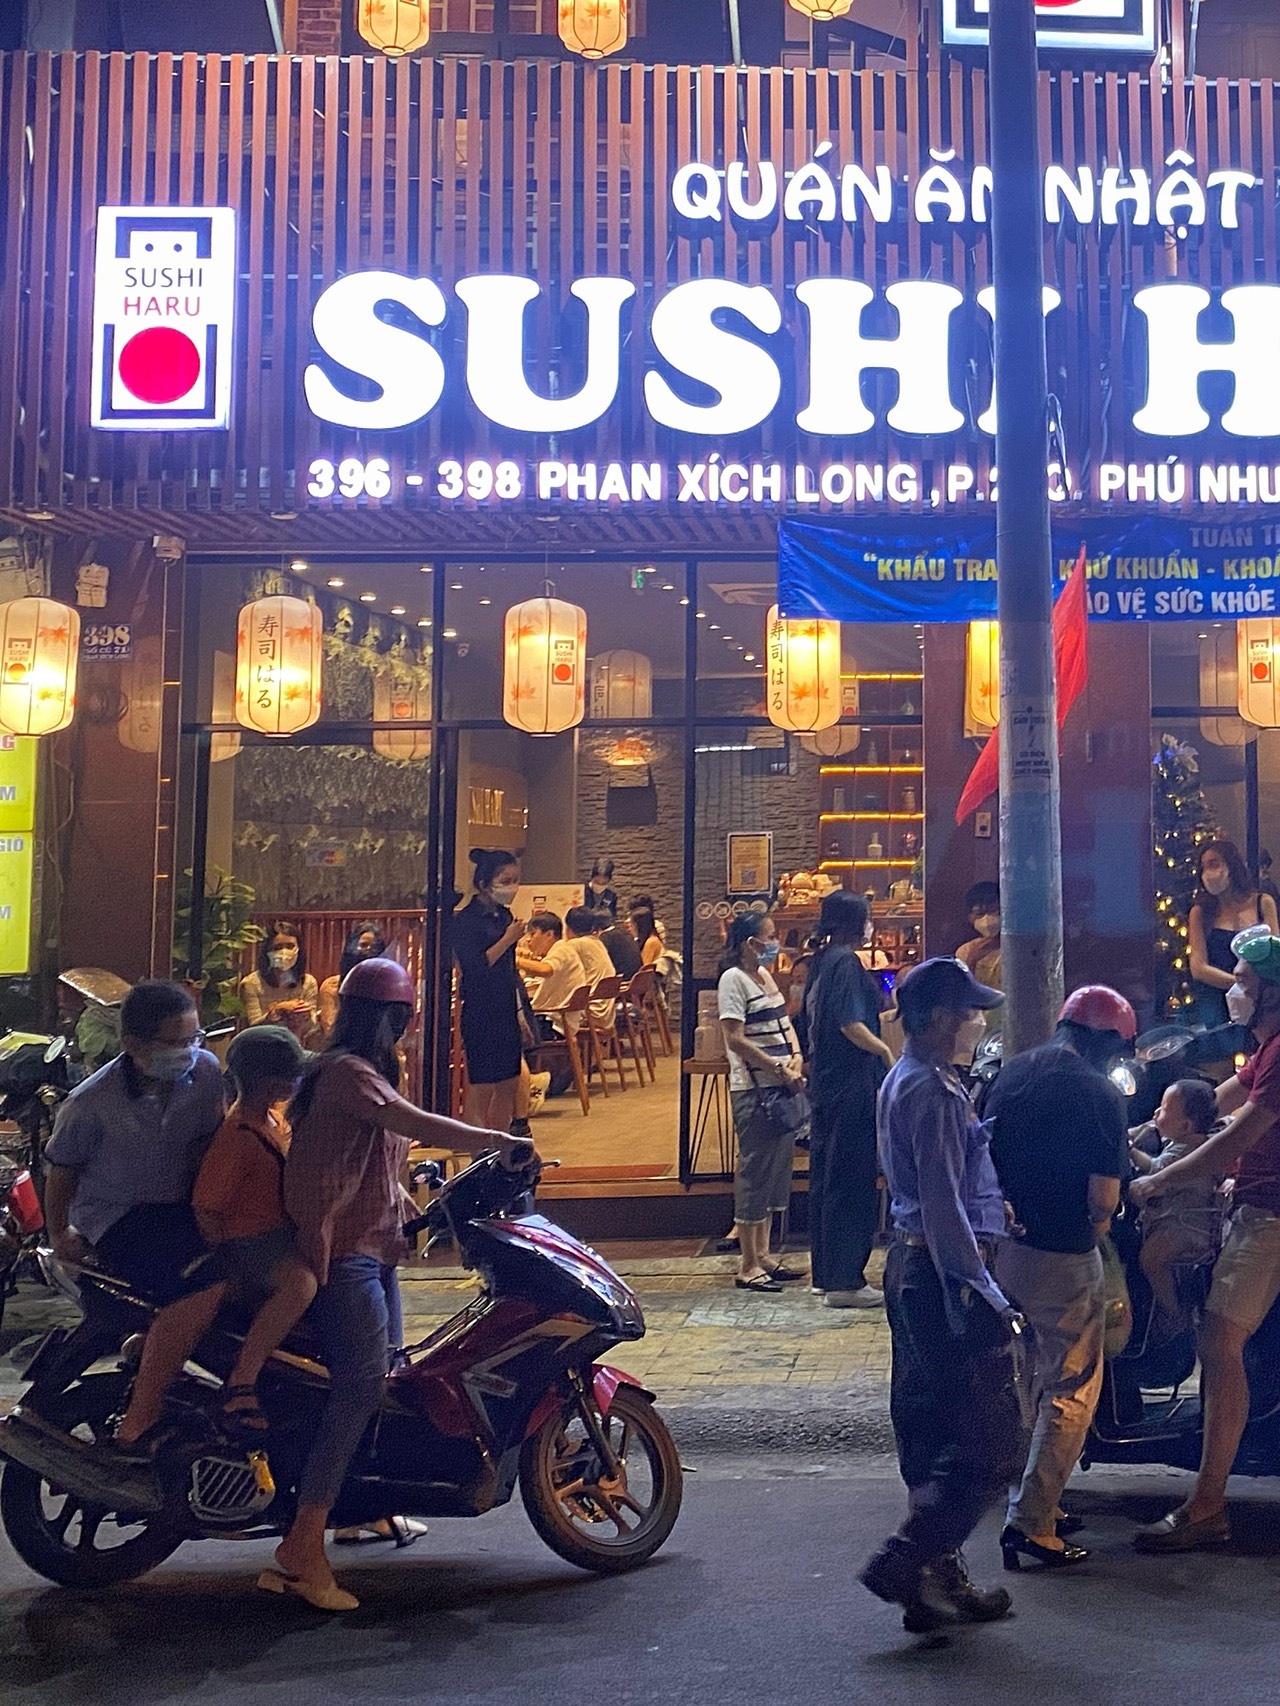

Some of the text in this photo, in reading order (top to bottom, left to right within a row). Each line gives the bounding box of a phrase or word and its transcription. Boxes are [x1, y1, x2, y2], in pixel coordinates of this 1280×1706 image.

[672, 140, 892, 223] QUÁN
[1044, 148, 1255, 240] NHẬT
[124, 267, 203, 288] SUSHI
[124, 296, 200, 316] HARU
[307, 457, 391, 499] 396
[405, 475, 423, 486] -
[437, 459, 521, 500] 398
[540, 461, 661, 501] PHAN
[678, 453, 780, 502] XÍCH
[1100, 455, 1185, 502] PHÚ
[1116, 550, 1198, 580] KHUẨN
[1116, 586, 1146, 619] VỆ
[1155, 584, 1203, 614] SỨC
[1212, 583, 1275, 613] KHỎE
[83, 625, 130, 646] 398
[257, 614, 279, 709] 寿司はる
